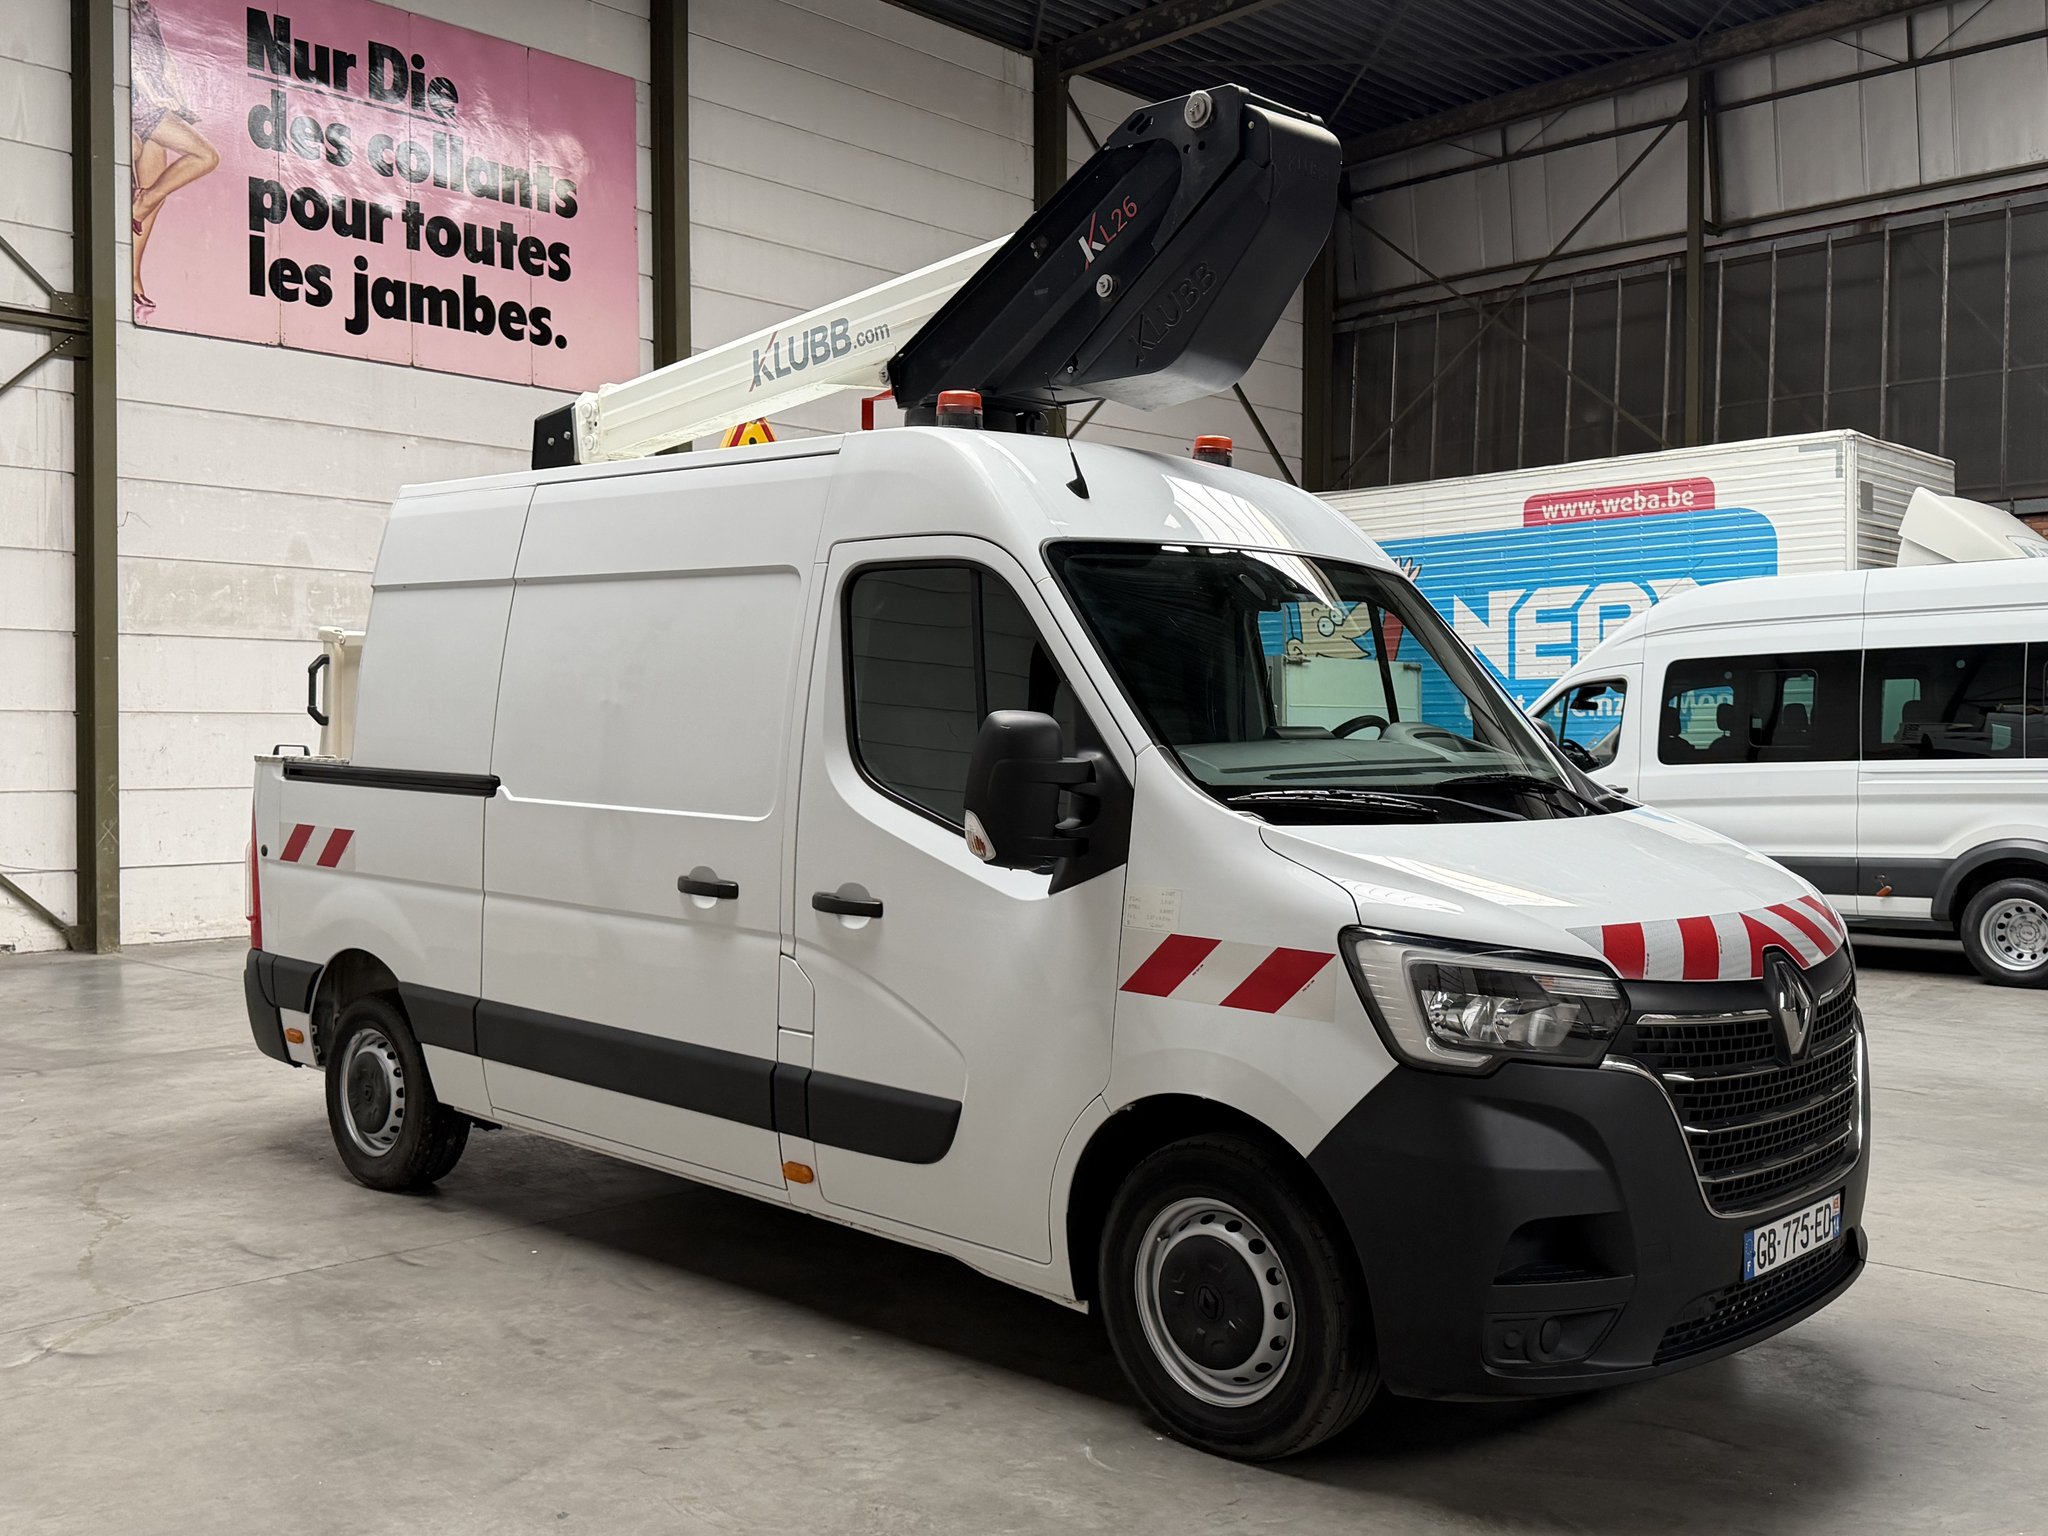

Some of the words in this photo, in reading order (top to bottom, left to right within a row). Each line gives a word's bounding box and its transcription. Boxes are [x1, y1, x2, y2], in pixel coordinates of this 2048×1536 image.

[246, 7, 357, 93] Nur
[368, 40, 459, 117] Die
[247, 89, 352, 168] des
[367, 130, 579, 219] collants
[247, 174, 394, 247] pour
[402, 201, 571, 282] toutes
[1079, 195, 1138, 272] KL26
[247, 235, 333, 309] les
[346, 256, 568, 350] jambes.
[1129, 261, 1217, 367] KLUBB
[749, 317, 891, 392] KLUBB.com
[1541, 486, 1695, 519] www.weba.be
[1453, 577, 1700, 680] NER
[1747, 1260, 1752, 1273] F
[1757, 1203, 1832, 1270] GB-775-ED
